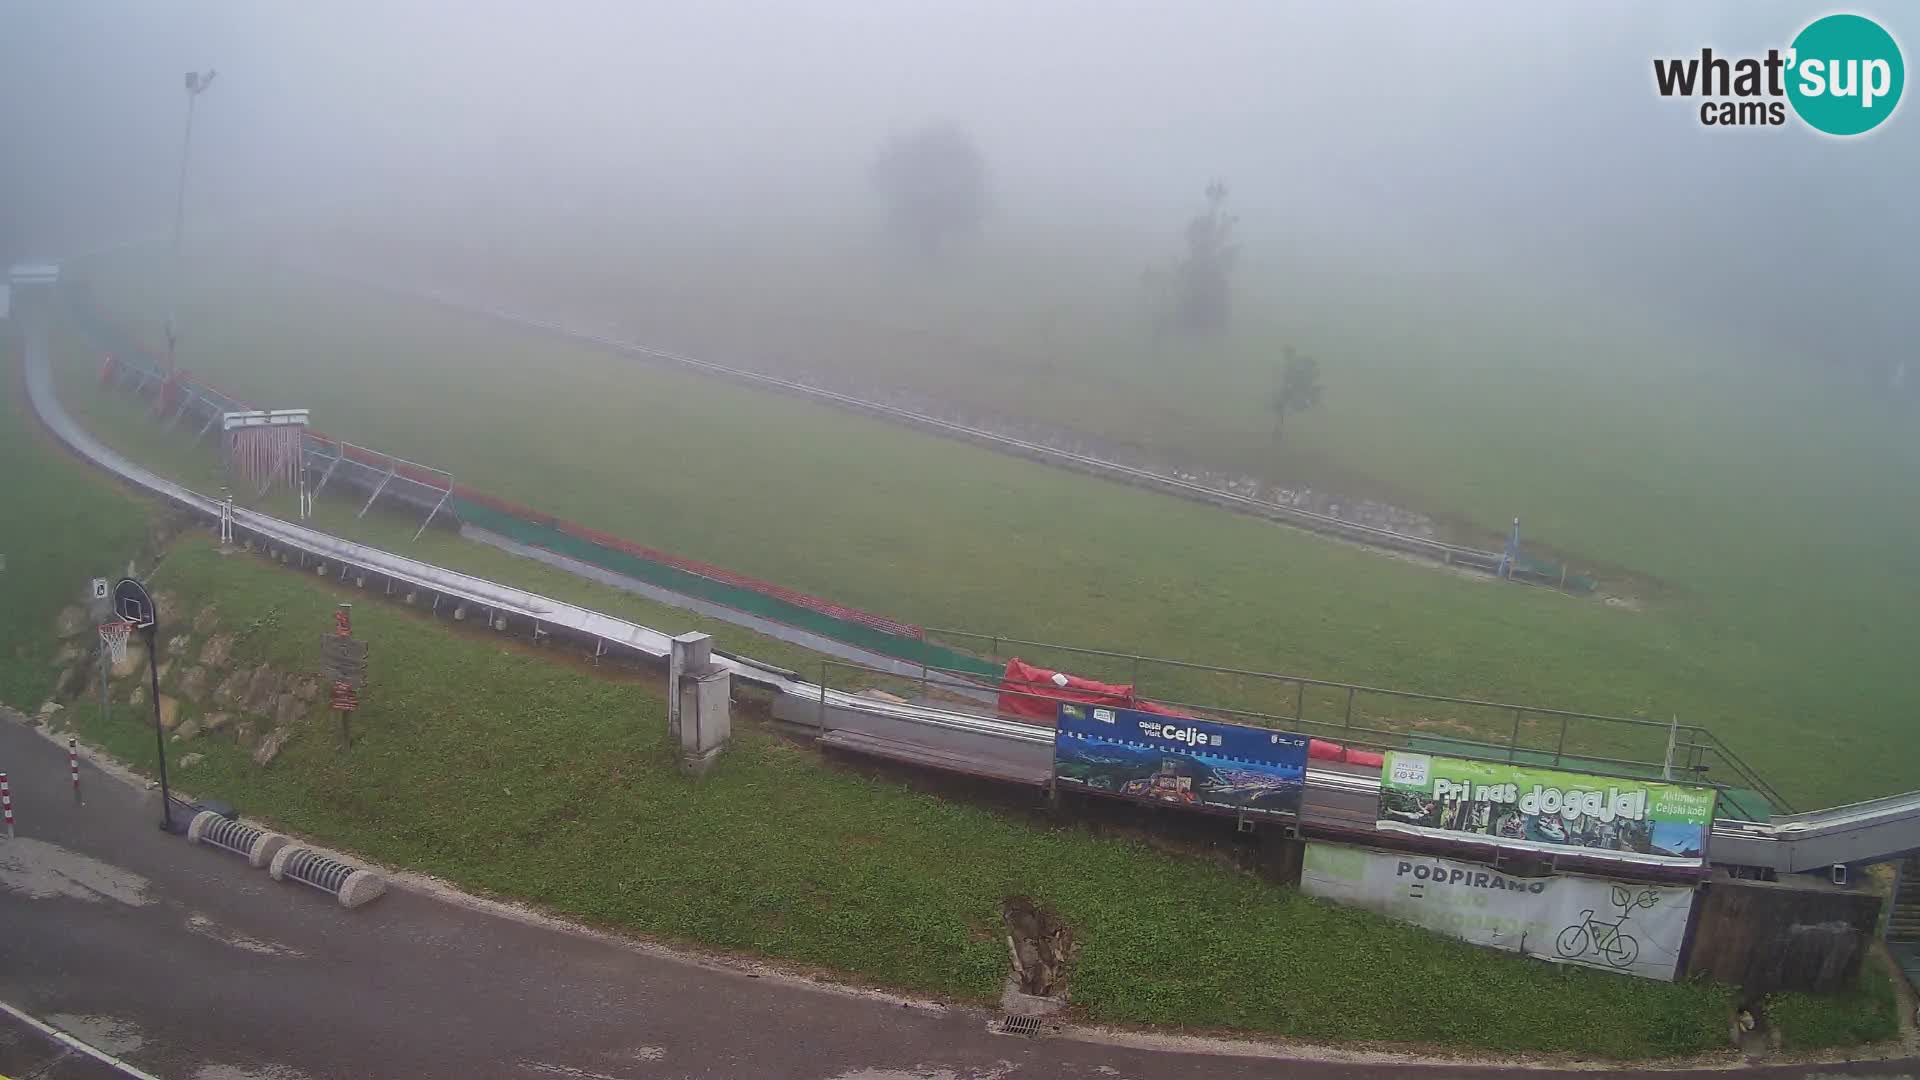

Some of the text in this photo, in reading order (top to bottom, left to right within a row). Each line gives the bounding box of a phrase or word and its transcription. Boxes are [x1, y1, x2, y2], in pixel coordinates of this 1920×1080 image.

[1144, 729, 1161, 738] Visit
[1162, 724, 1208, 747] Celje
[1432, 778, 1471, 801] Pri
[1475, 783, 1518, 803] nas
[1396, 861, 1545, 895] PODPIRAMO
